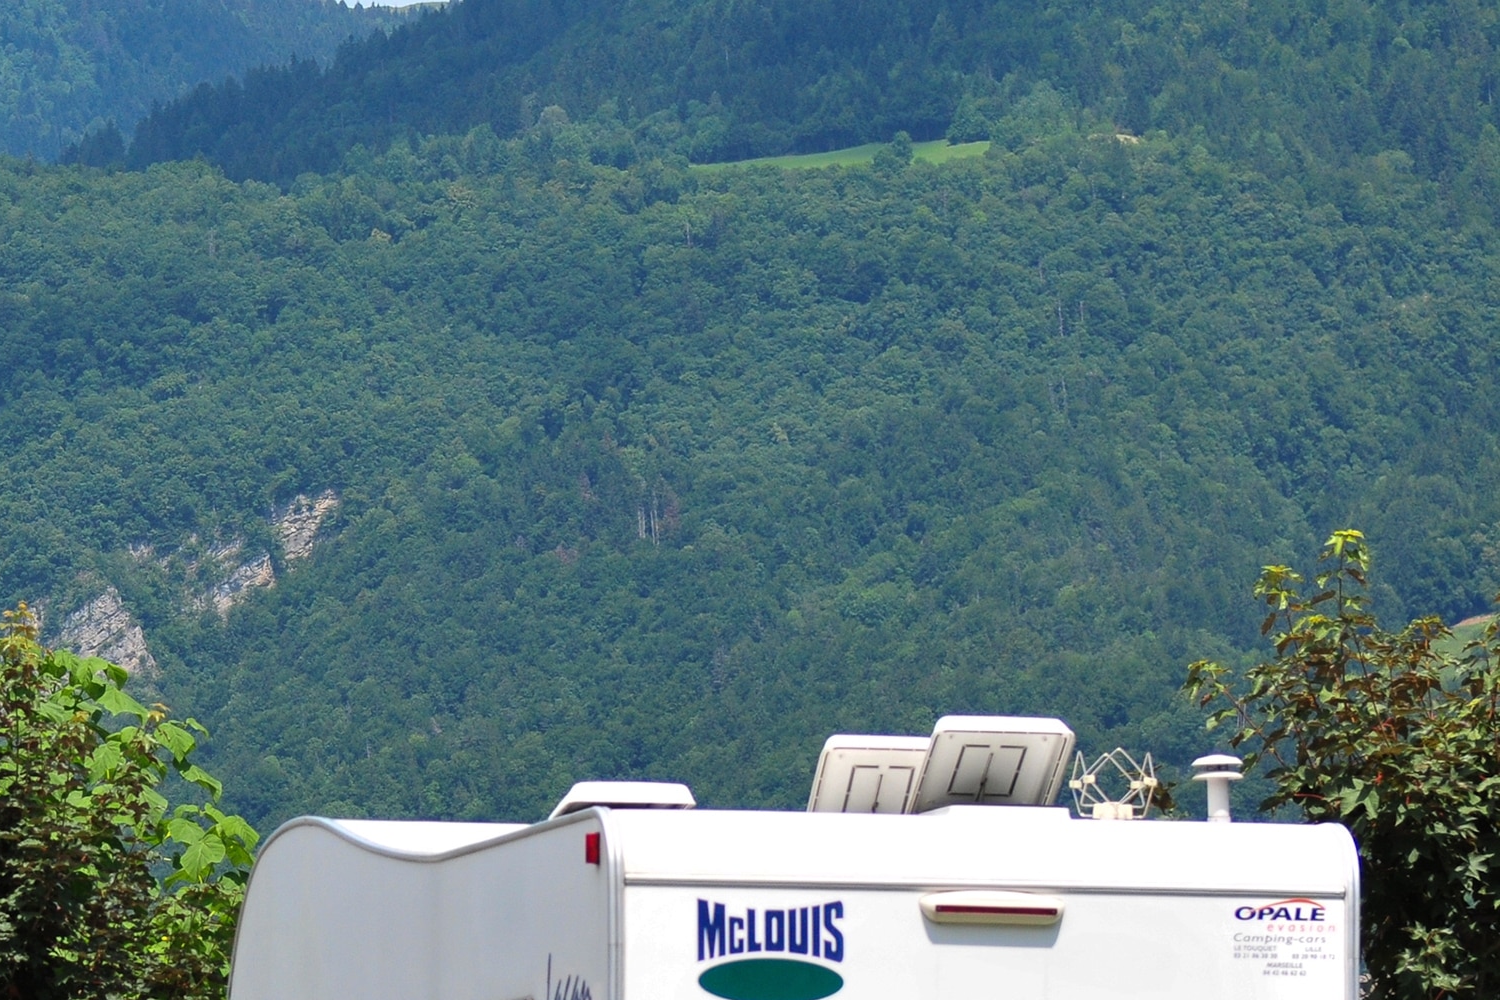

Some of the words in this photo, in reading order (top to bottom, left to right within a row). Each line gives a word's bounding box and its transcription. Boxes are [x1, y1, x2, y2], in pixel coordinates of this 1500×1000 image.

[1234, 906, 1325, 921] OPALE
[1266, 924, 1336, 932] evasion
[1233, 932, 1326, 945] Camping-cars
